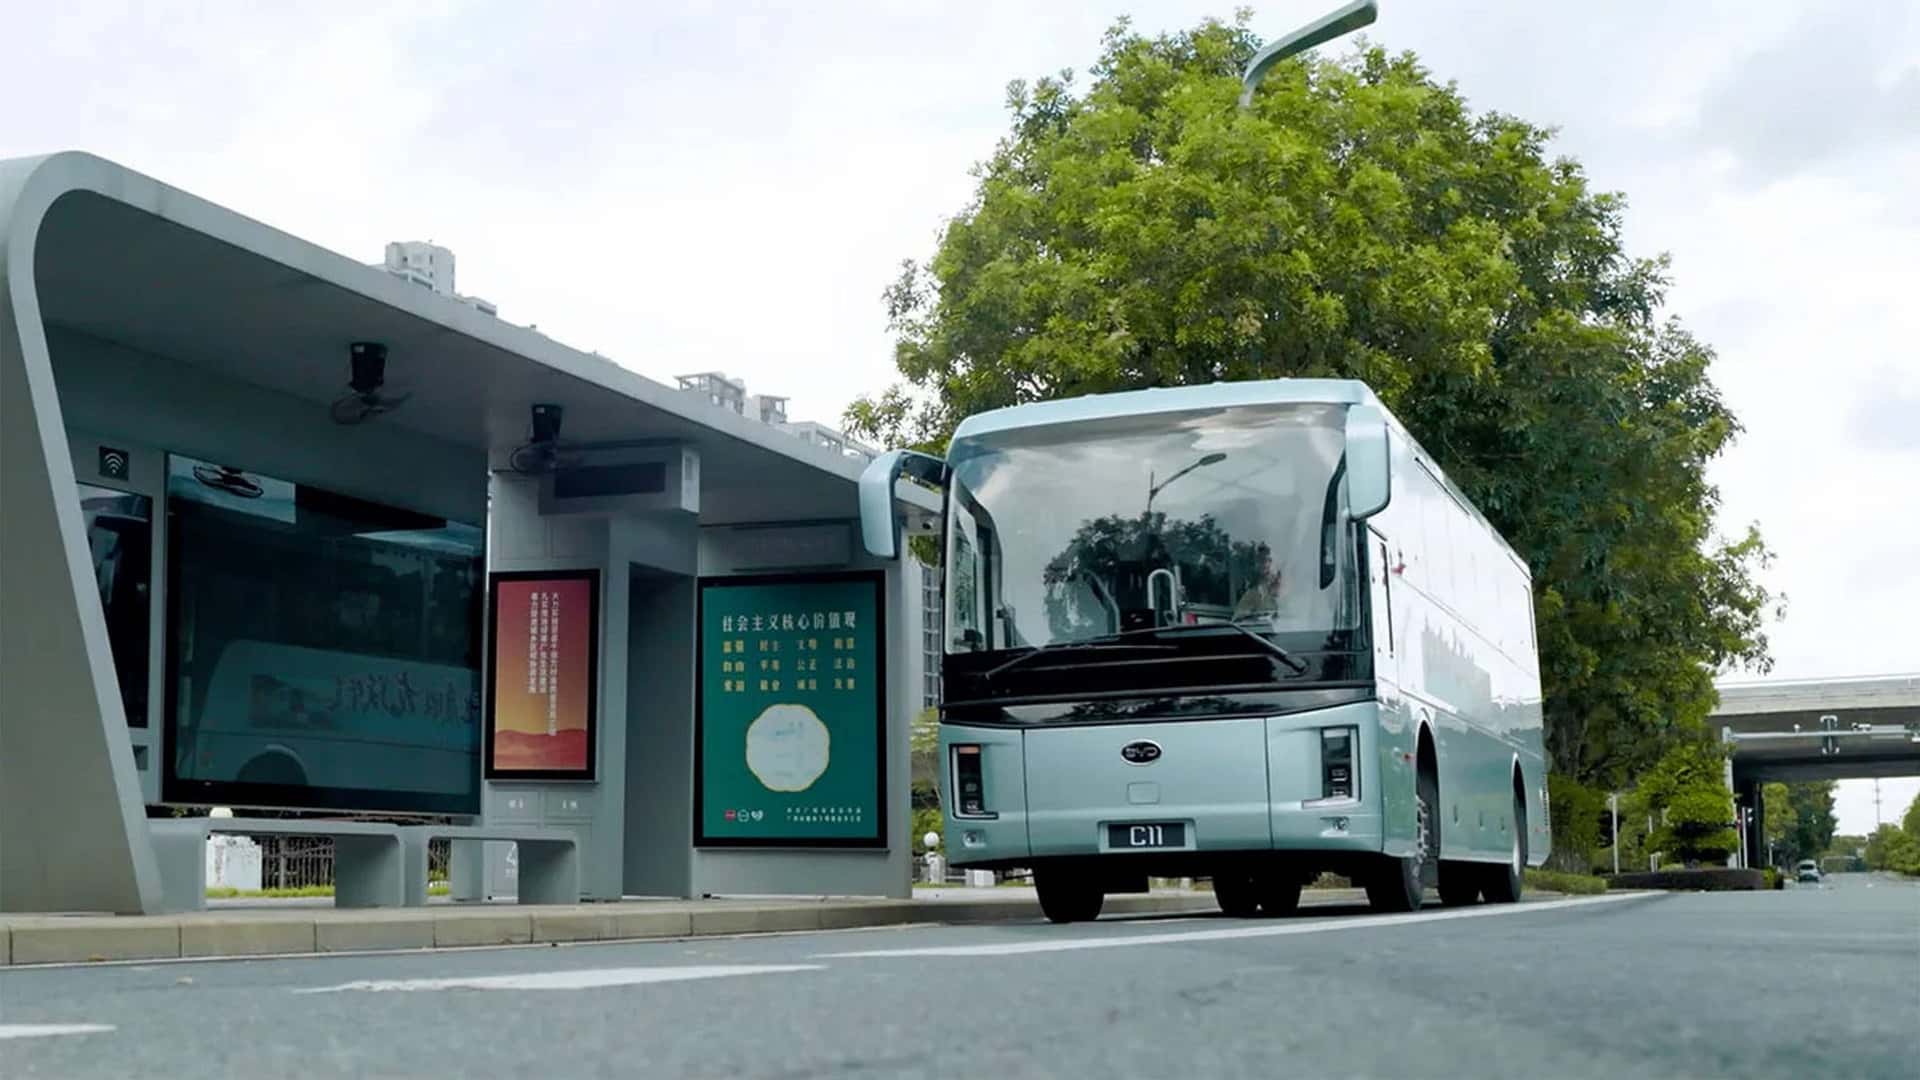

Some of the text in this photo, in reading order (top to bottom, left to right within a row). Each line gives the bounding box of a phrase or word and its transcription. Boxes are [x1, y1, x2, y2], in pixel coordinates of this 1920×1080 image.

[722, 611, 856, 632] 社会主义核心价值观
[1125, 746, 1158, 758] BYD
[1130, 825, 1163, 846] C11
